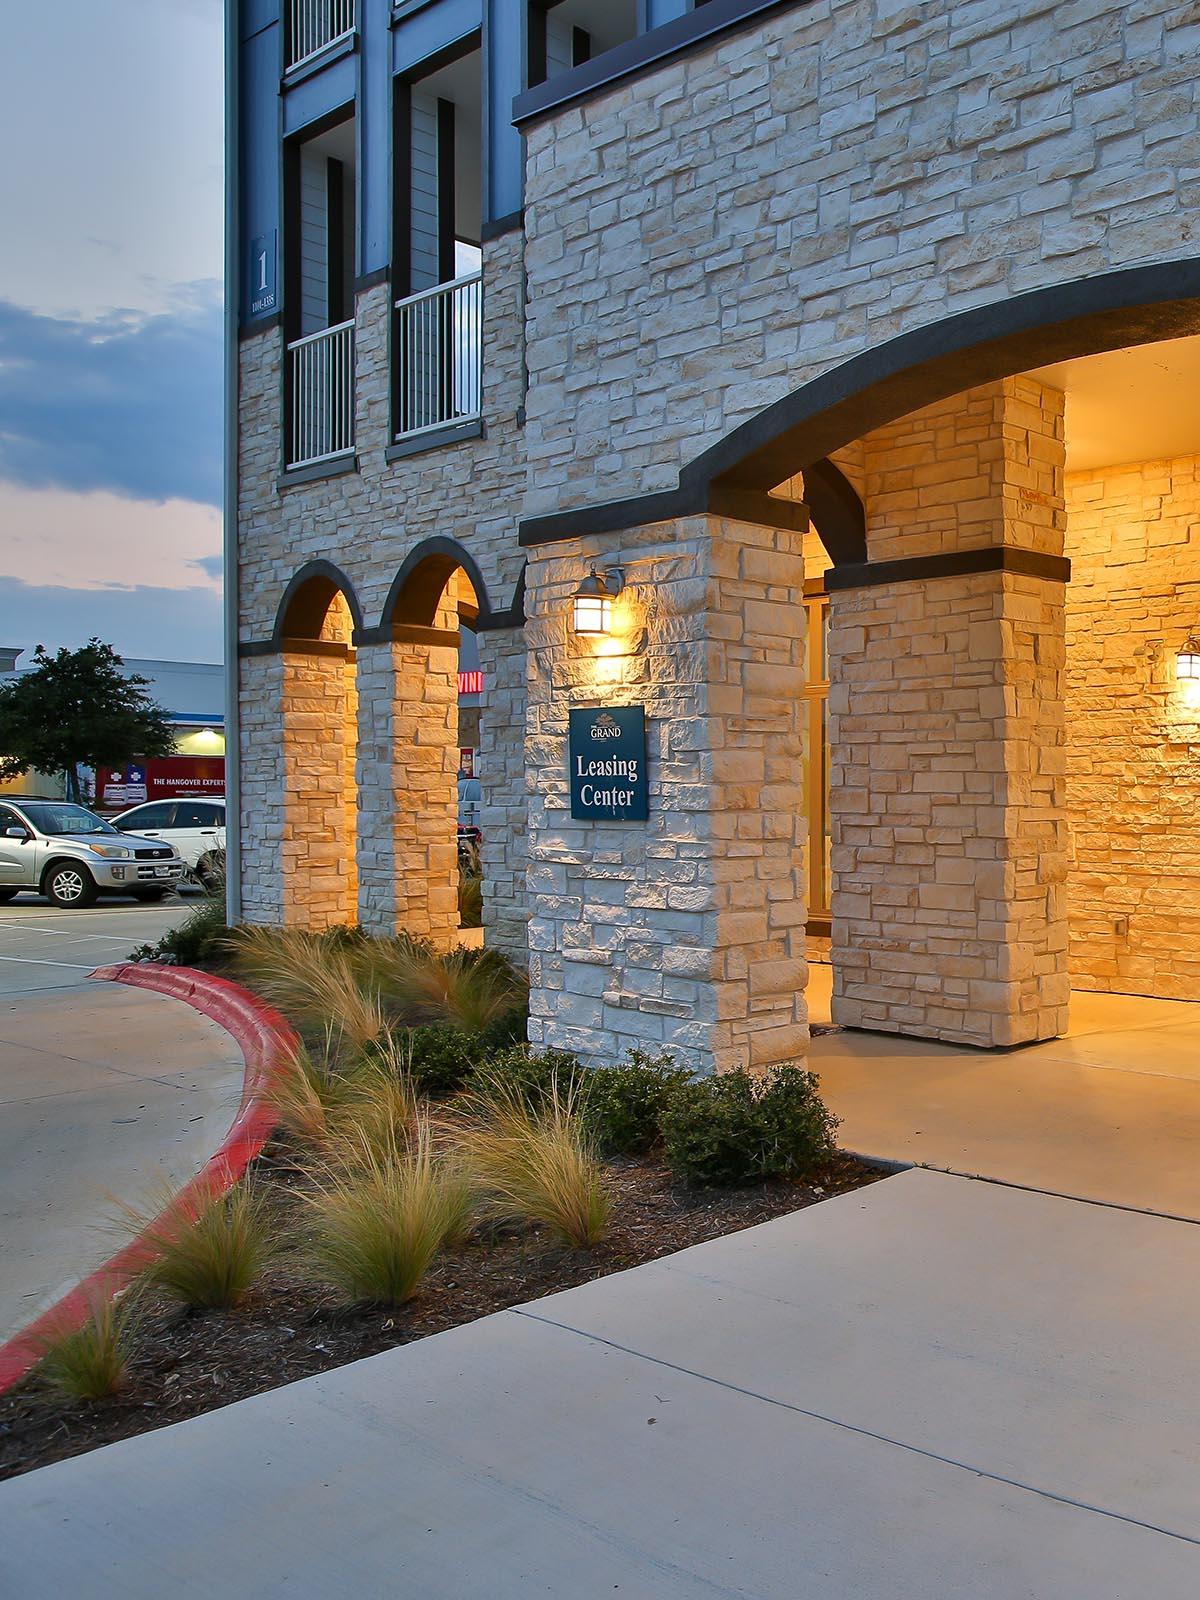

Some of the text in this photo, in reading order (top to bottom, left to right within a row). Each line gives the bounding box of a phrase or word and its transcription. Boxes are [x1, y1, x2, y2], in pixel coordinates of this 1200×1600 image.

[258, 250, 268, 291] 1
[591, 728, 621, 738] GRAND
[576, 754, 638, 782] Leasing
[153, 778, 165, 786] THE
[166, 778, 201, 786] HANGOVER
[580, 784, 635, 806] Center
